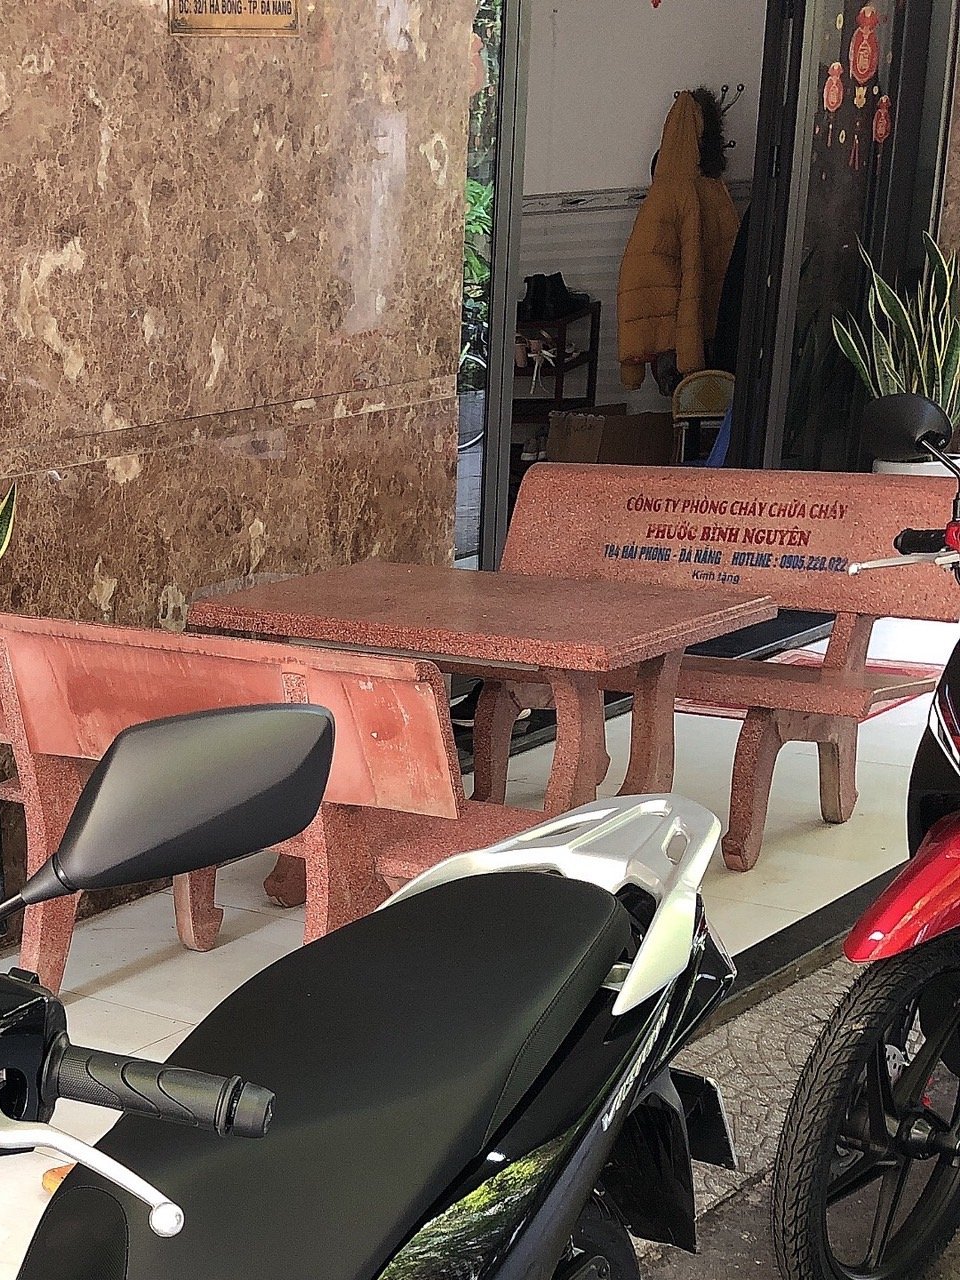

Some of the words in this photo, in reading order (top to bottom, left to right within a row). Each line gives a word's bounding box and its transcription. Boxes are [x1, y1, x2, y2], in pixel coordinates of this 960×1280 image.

[626, 494, 661, 512] CÔNG
[664, 499, 680, 513] TY
[681, 496, 728, 515] PHÒNG
[730, 498, 768, 517] CHÁY
[768, 498, 806, 518] CHỮA
[809, 500, 848, 520] CHÁY
[646, 520, 698, 541] PHƯỚC
[700, 523, 740, 543] BÌNH
[742, 525, 812, 547] NGUYÊN
